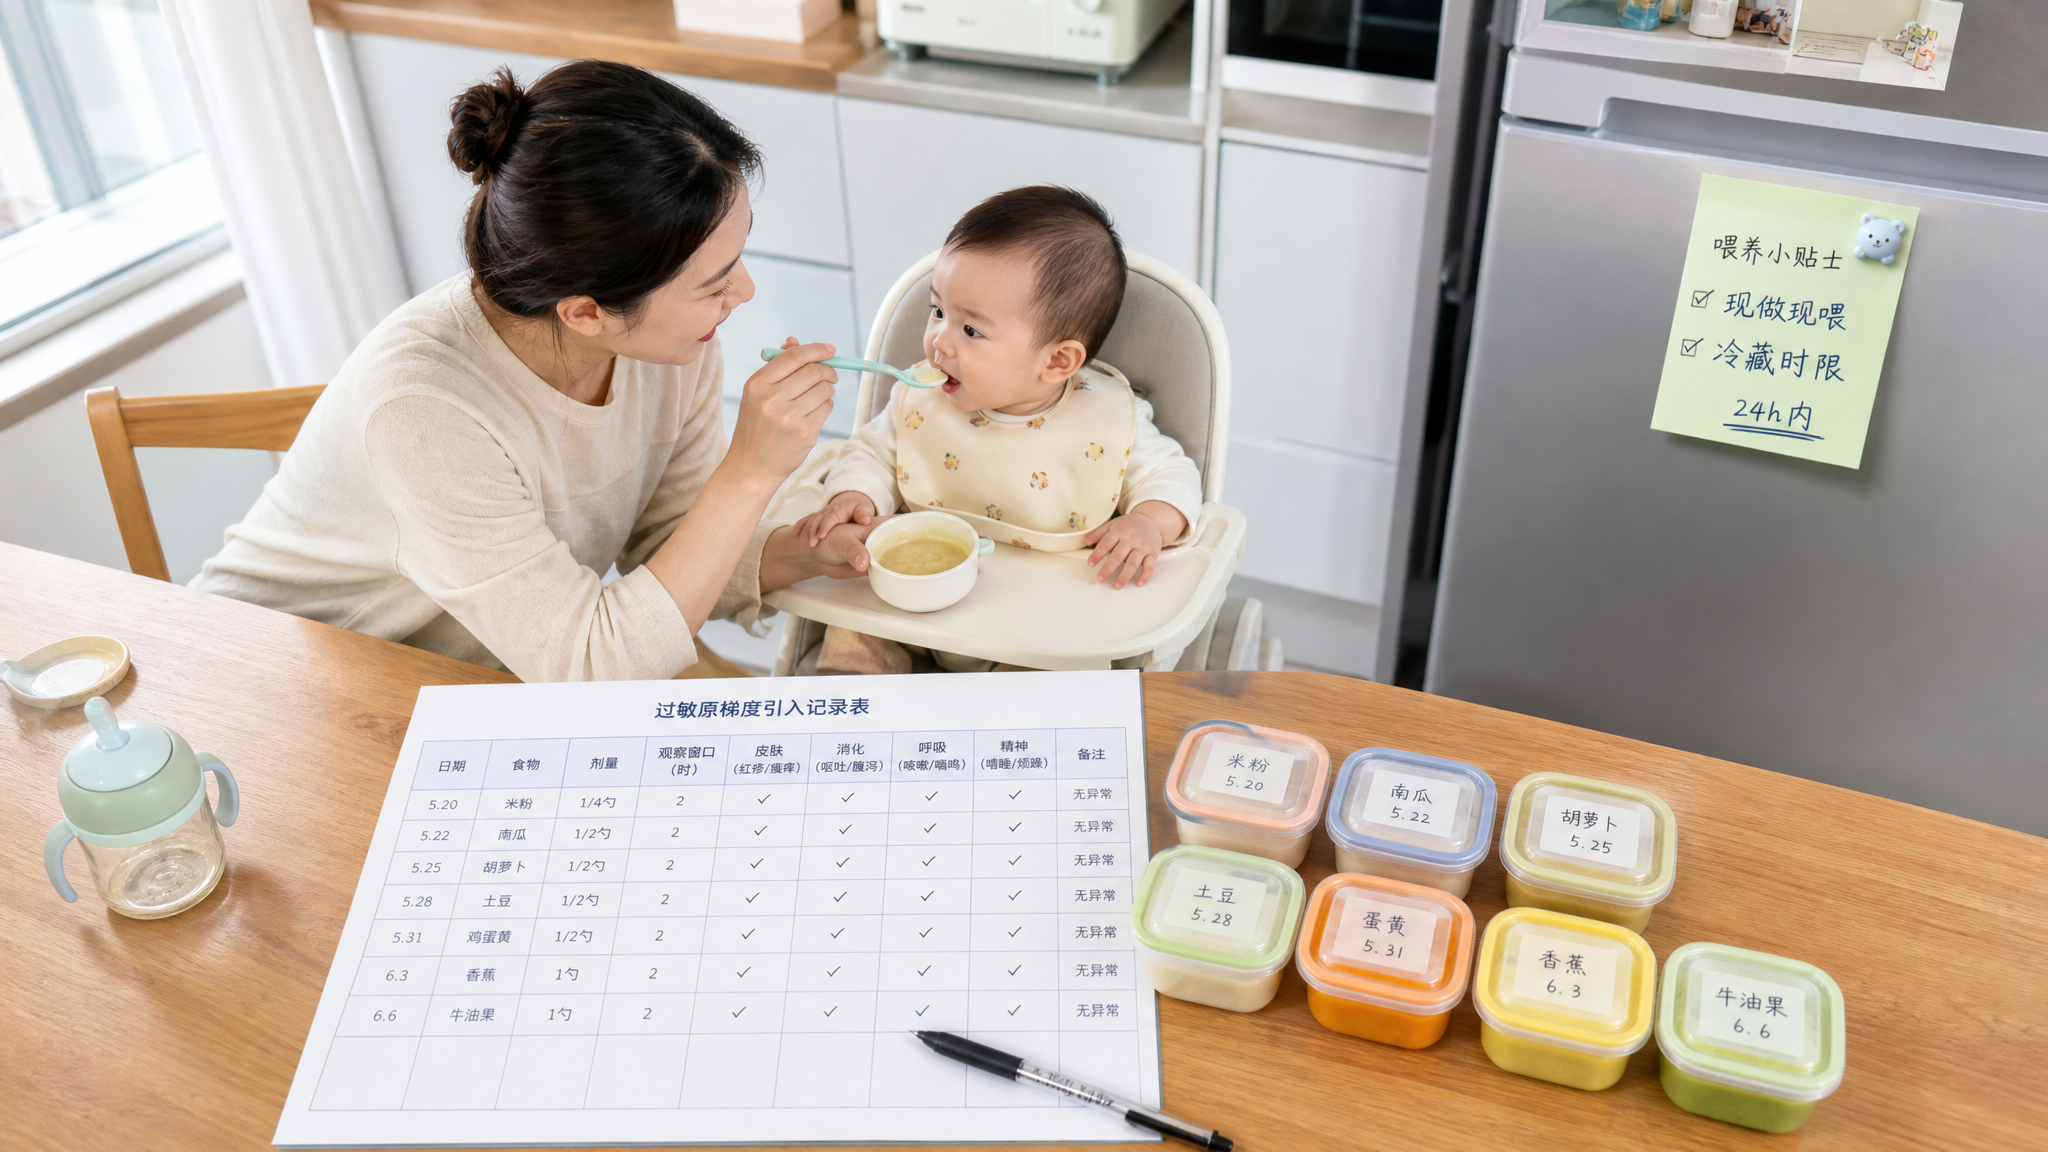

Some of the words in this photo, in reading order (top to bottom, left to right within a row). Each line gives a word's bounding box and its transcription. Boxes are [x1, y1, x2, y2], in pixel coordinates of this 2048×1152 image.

[1713, 234, 1843, 270] 喂养小贴士
[1723, 291, 1847, 331] 现做现喂
[1712, 338, 1845, 382] 冷藏时限
[654, 697, 870, 719] 过敏原梯度引入记录表
[657, 745, 716, 760] 观察窗口
[754, 744, 784, 758] 皮肤
[836, 742, 865, 756] 消化
[918, 741, 947, 754] 呼吸
[999, 739, 1029, 753] 精神
[1077, 748, 1106, 761] 备注
[438, 760, 467, 773] 日期
[512, 758, 541, 771] 食物
[589, 756, 619, 770] 剂量
[671, 763, 698, 777] (时)
[1227, 753, 1271, 773] 米粉
[1225, 774, 1264, 791] 5.20
[675, 795, 685, 807] 2
[1073, 787, 1113, 801] 无异常
[1390, 783, 1433, 805] 南瓜
[428, 799, 459, 811] 5.20
[504, 797, 534, 810] 米粉
[580, 796, 617, 809] 1/4勺
[1390, 805, 1431, 825] 5.22
[1560, 808, 1618, 833] 胡萝卜
[574, 826, 612, 840] 1/2勺
[670, 826, 680, 838] 2
[1073, 820, 1114, 833] 无异常
[419, 830, 450, 842] 5.22
[497, 828, 527, 841] 南瓜
[1569, 834, 1613, 854] 5.25
[482, 860, 526, 874] 胡萝卜
[567, 859, 606, 873] 1/2勺
[665, 859, 675, 871] 2
[1074, 853, 1115, 867] 无异常
[410, 862, 442, 874] 5.25
[401, 895, 433, 908] 5.28
[481, 894, 512, 908] 土豆
[561, 893, 600, 907] 1/2勺
[660, 893, 670, 905] 2
[1074, 888, 1116, 902] 无异常
[1193, 884, 1236, 905] 土豆
[1190, 907, 1233, 927] 5.28
[1362, 911, 1406, 937] 蛋黄
[392, 931, 422, 944] 5.31
[466, 930, 512, 944] 鸡蛋黄
[554, 929, 593, 943] 1/2勺
[654, 929, 664, 942] 2
[1075, 925, 1118, 939] 无异常
[1362, 938, 1403, 959] 5.31
[1538, 949, 1587, 976] 香蕉
[385, 969, 409, 982] 6.3
[466, 967, 497, 982] 香蕉
[555, 967, 580, 982] 1勺
[648, 967, 658, 980] 2
[1075, 963, 1119, 978] 无异常
[1546, 978, 1581, 999] 6.3
[1715, 986, 1788, 1018] 牛油果
[373, 1009, 398, 1022] 6.6
[449, 1007, 495, 1023] 牛油果
[547, 1007, 573, 1022] 1勺
[642, 1007, 652, 1020] 2
[1076, 1003, 1120, 1018] 无异常
[1733, 1018, 1771, 1039] 6.6
